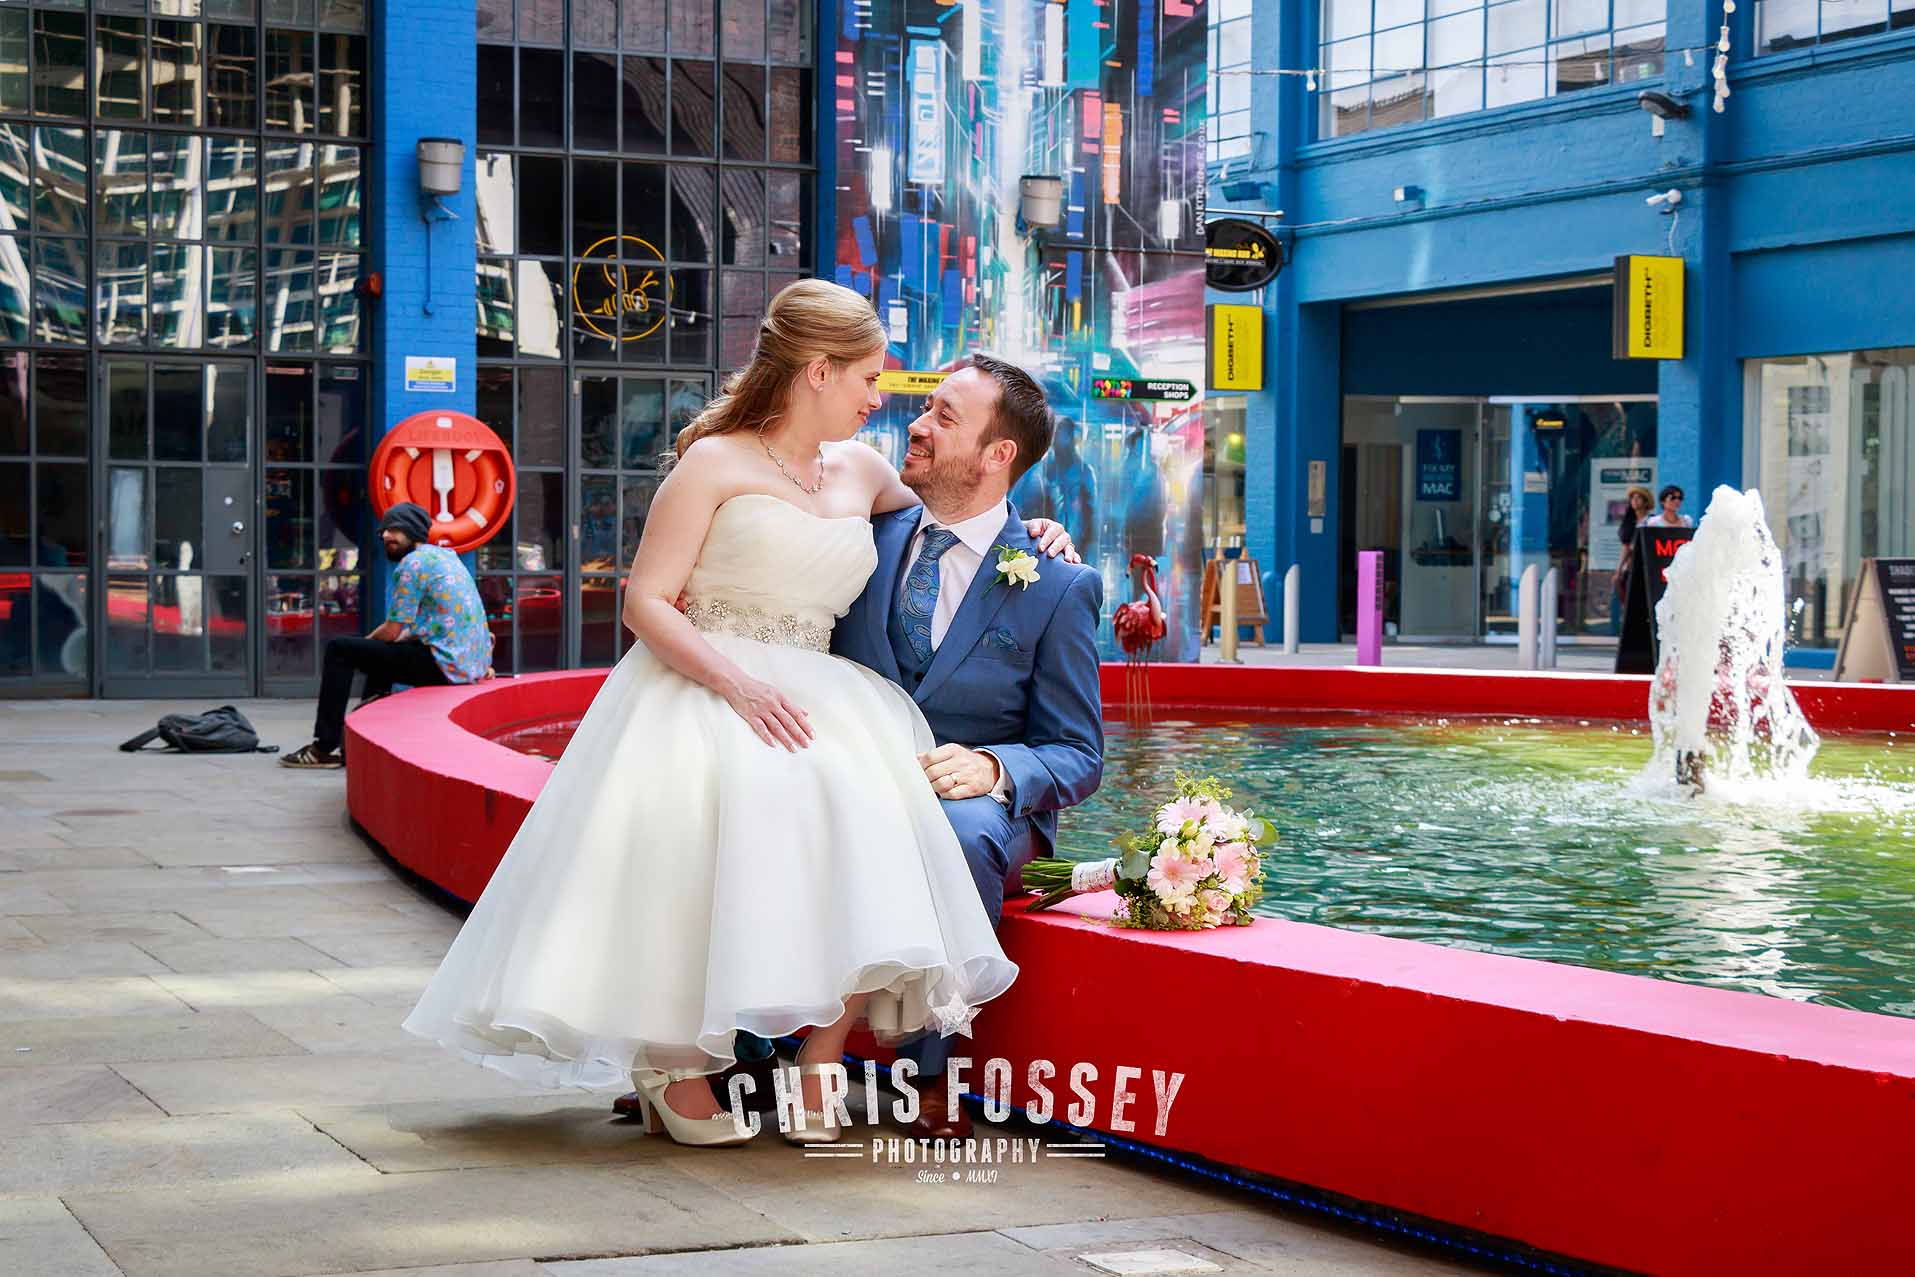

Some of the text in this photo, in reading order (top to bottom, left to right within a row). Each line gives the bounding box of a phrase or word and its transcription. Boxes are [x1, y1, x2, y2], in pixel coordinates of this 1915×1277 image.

[1196, 212, 1205, 235] DAN
[1146, 382, 1190, 391] RECEPTION
[1163, 391, 1190, 399] SHOPS
[1423, 482, 1454, 496] MAC
